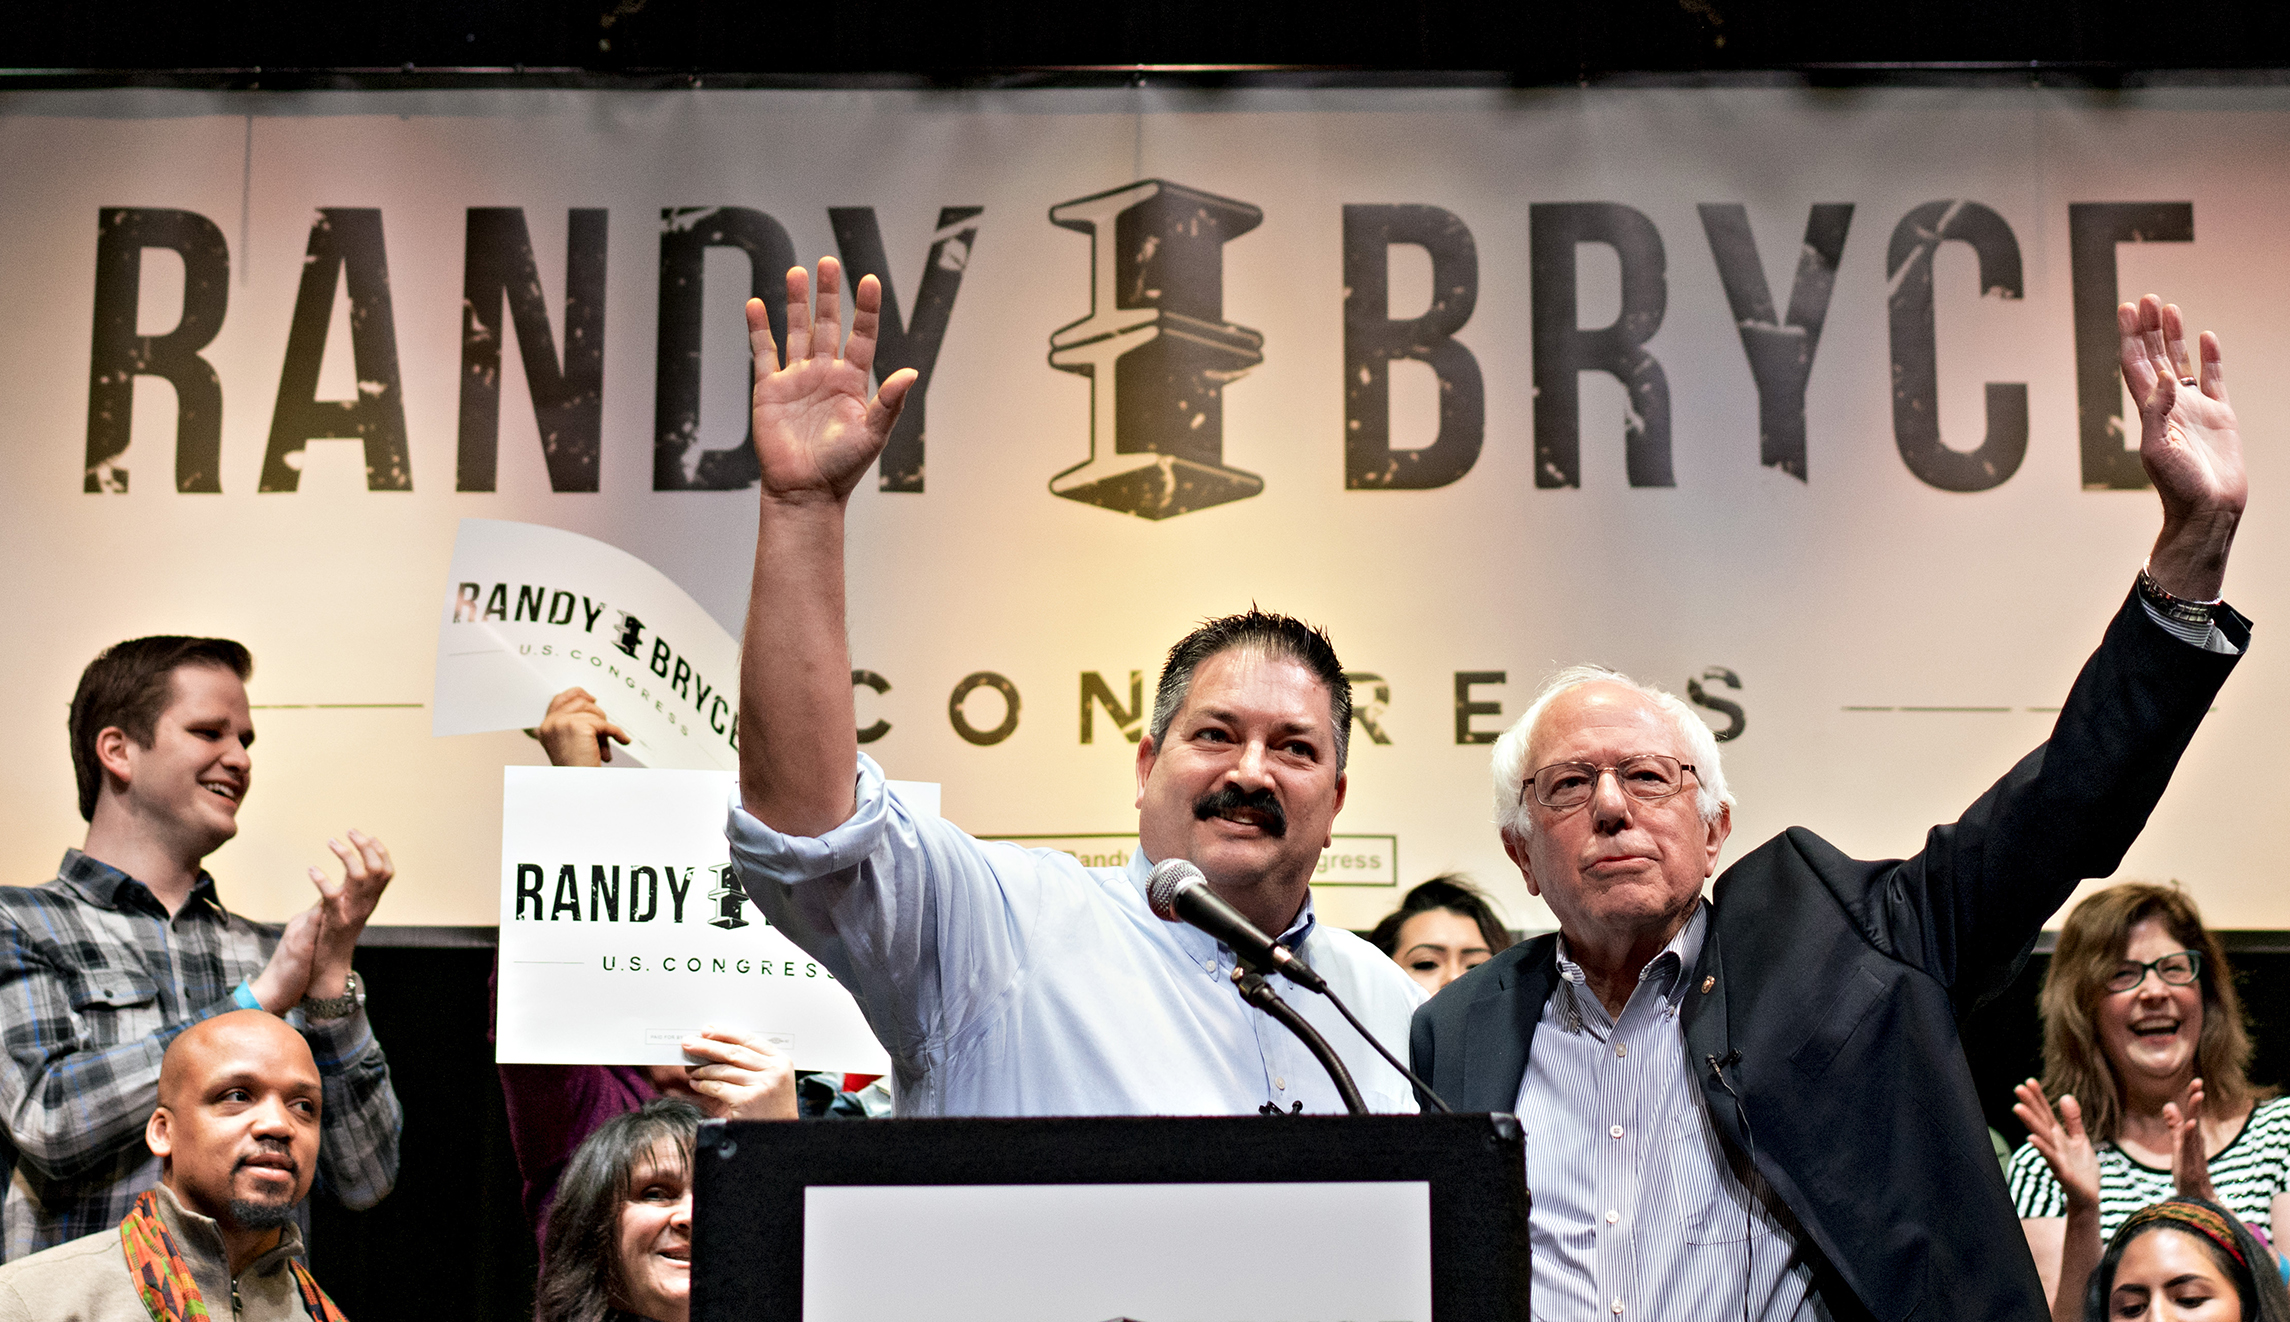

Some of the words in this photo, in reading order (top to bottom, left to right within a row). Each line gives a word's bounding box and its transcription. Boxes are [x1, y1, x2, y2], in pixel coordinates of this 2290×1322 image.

[83, 206, 985, 494] RANDY
[1341, 199, 2196, 493] BRYCE
[452, 581, 607, 634] RANDY
[518, 644, 560, 657] U.S.
[569, 649, 689, 737] CONGRESS
[850, 665, 1747, 747] CONRES
[515, 862, 696, 924] RANDY
[1316, 854, 1382, 874] gress
[602, 956, 650, 973] U.S.
[662, 956, 836, 980] CONGRES
